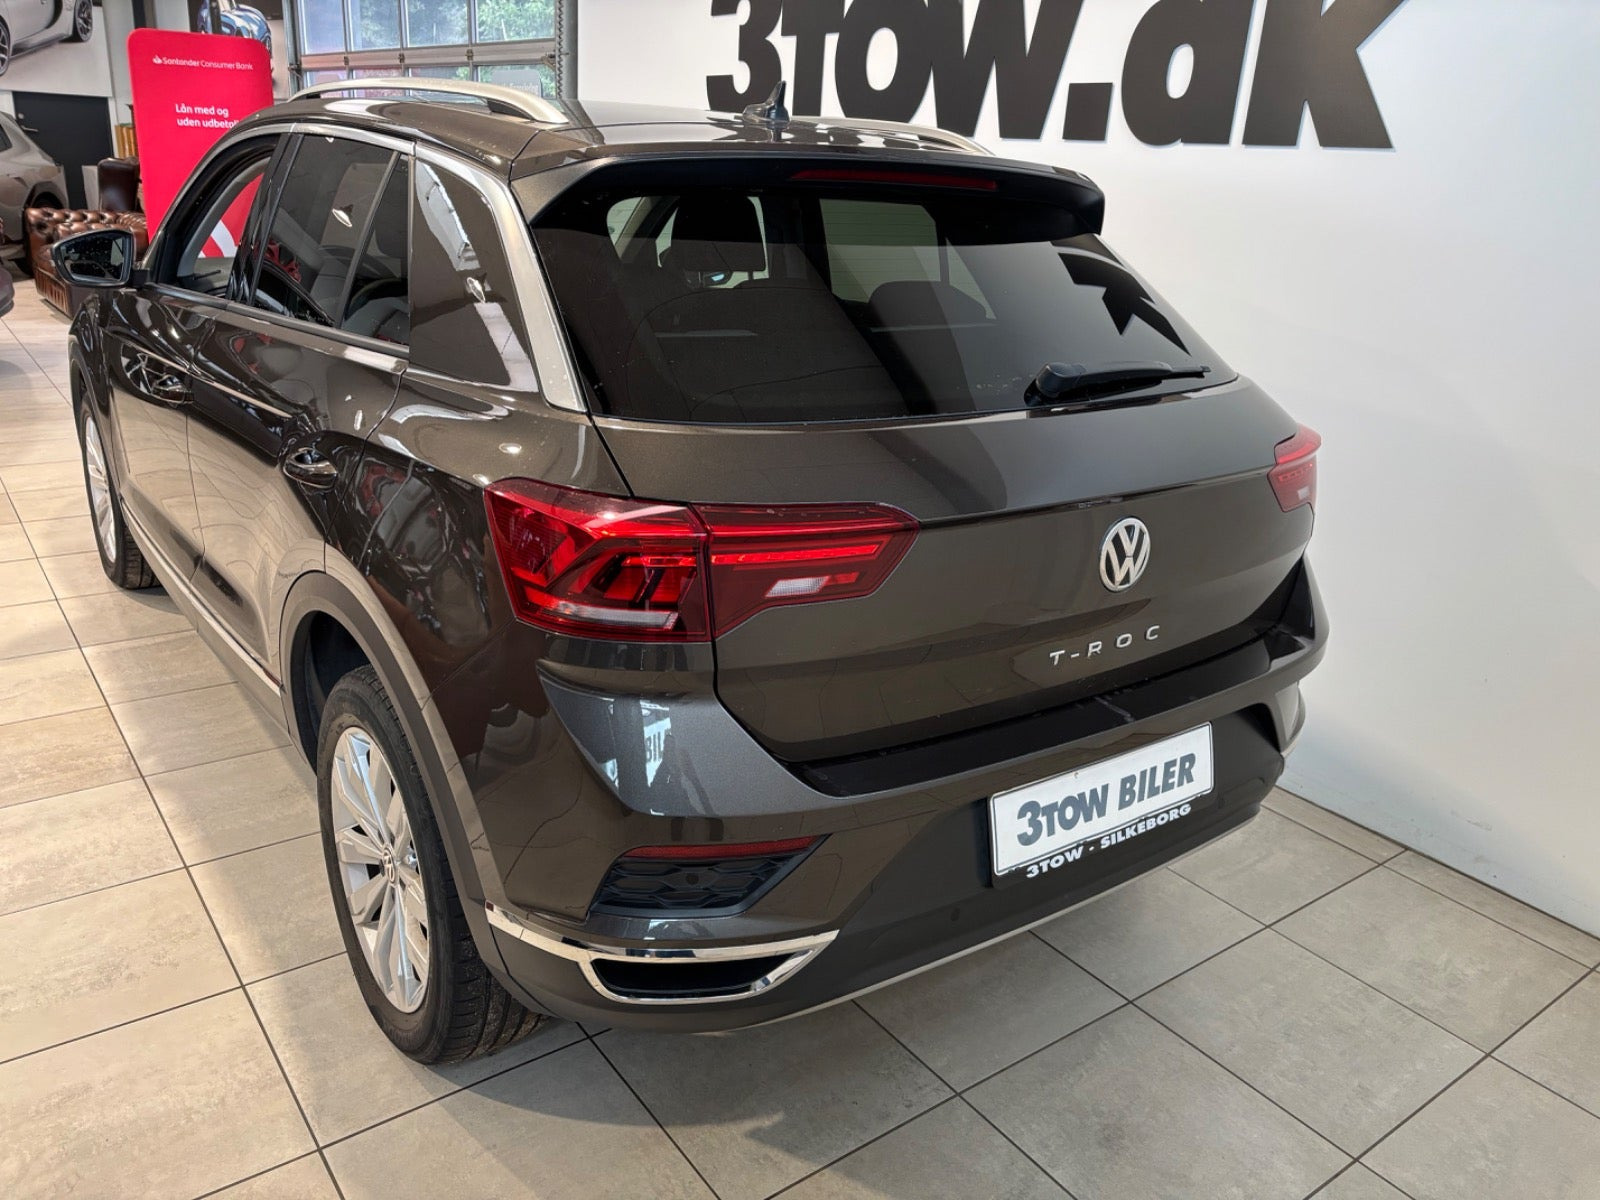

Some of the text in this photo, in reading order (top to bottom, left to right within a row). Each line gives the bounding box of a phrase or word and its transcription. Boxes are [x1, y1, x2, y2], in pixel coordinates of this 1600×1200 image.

[162, 56, 254, 70] Santander Consumer Bank
[175, 102, 229, 119] Lån med og
[176, 117, 201, 127] uden
[1049, 625, 1160, 666] T-ROC
[1016, 752, 1196, 847] 3TOW BILER
[1025, 845, 1084, 879] 3TOW
[1100, 803, 1192, 850] SILKEBORG
